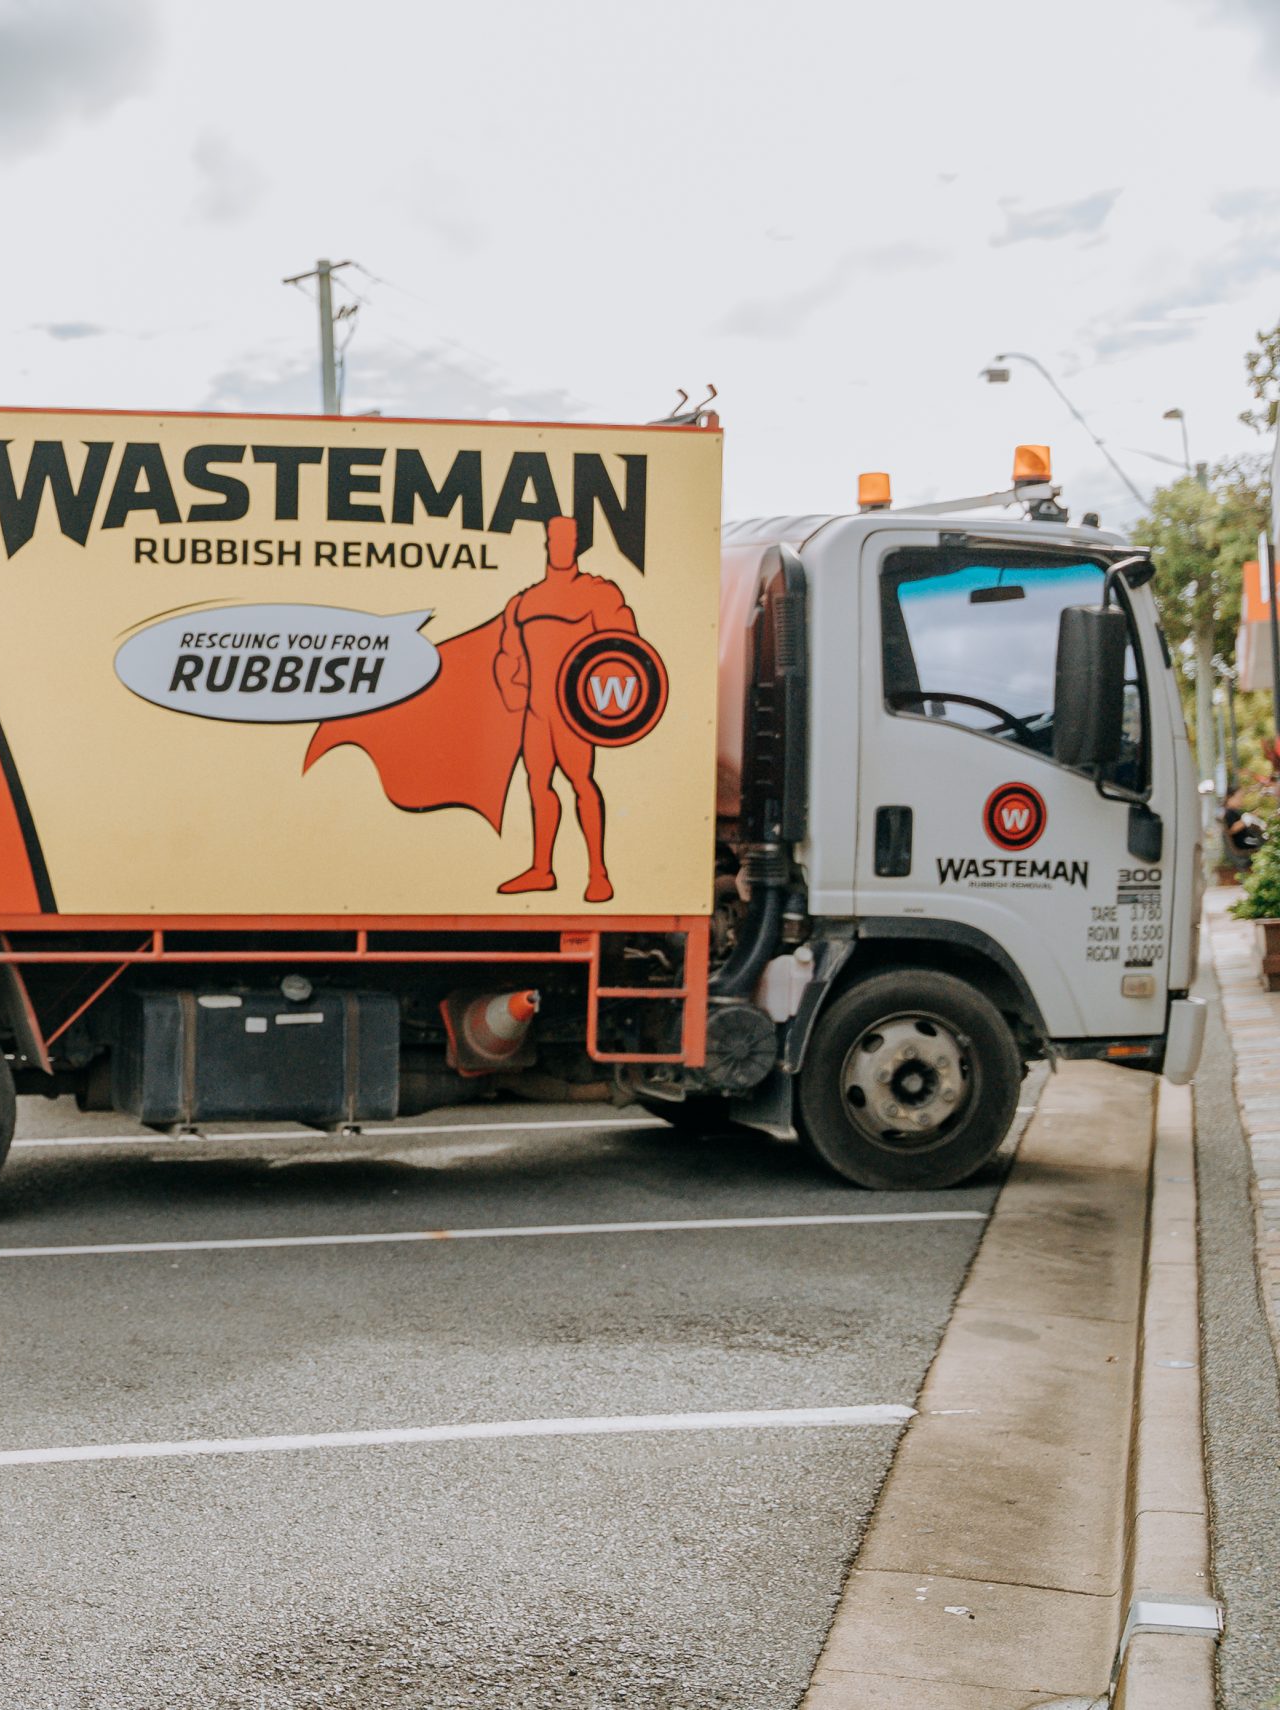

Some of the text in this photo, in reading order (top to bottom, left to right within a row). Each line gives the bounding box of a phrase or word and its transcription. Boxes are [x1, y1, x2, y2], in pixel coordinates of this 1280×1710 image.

[134, 537, 499, 571] RUBBISH REMOVAL
[180, 632, 391, 652] RESCUING YOU FROM
[168, 654, 386, 695] RUBBISH
[590, 676, 637, 711] W
[1001, 808, 1029, 831] W
[936, 858, 1089, 889] WASTEMAN
[1117, 869, 1162, 883] 300
